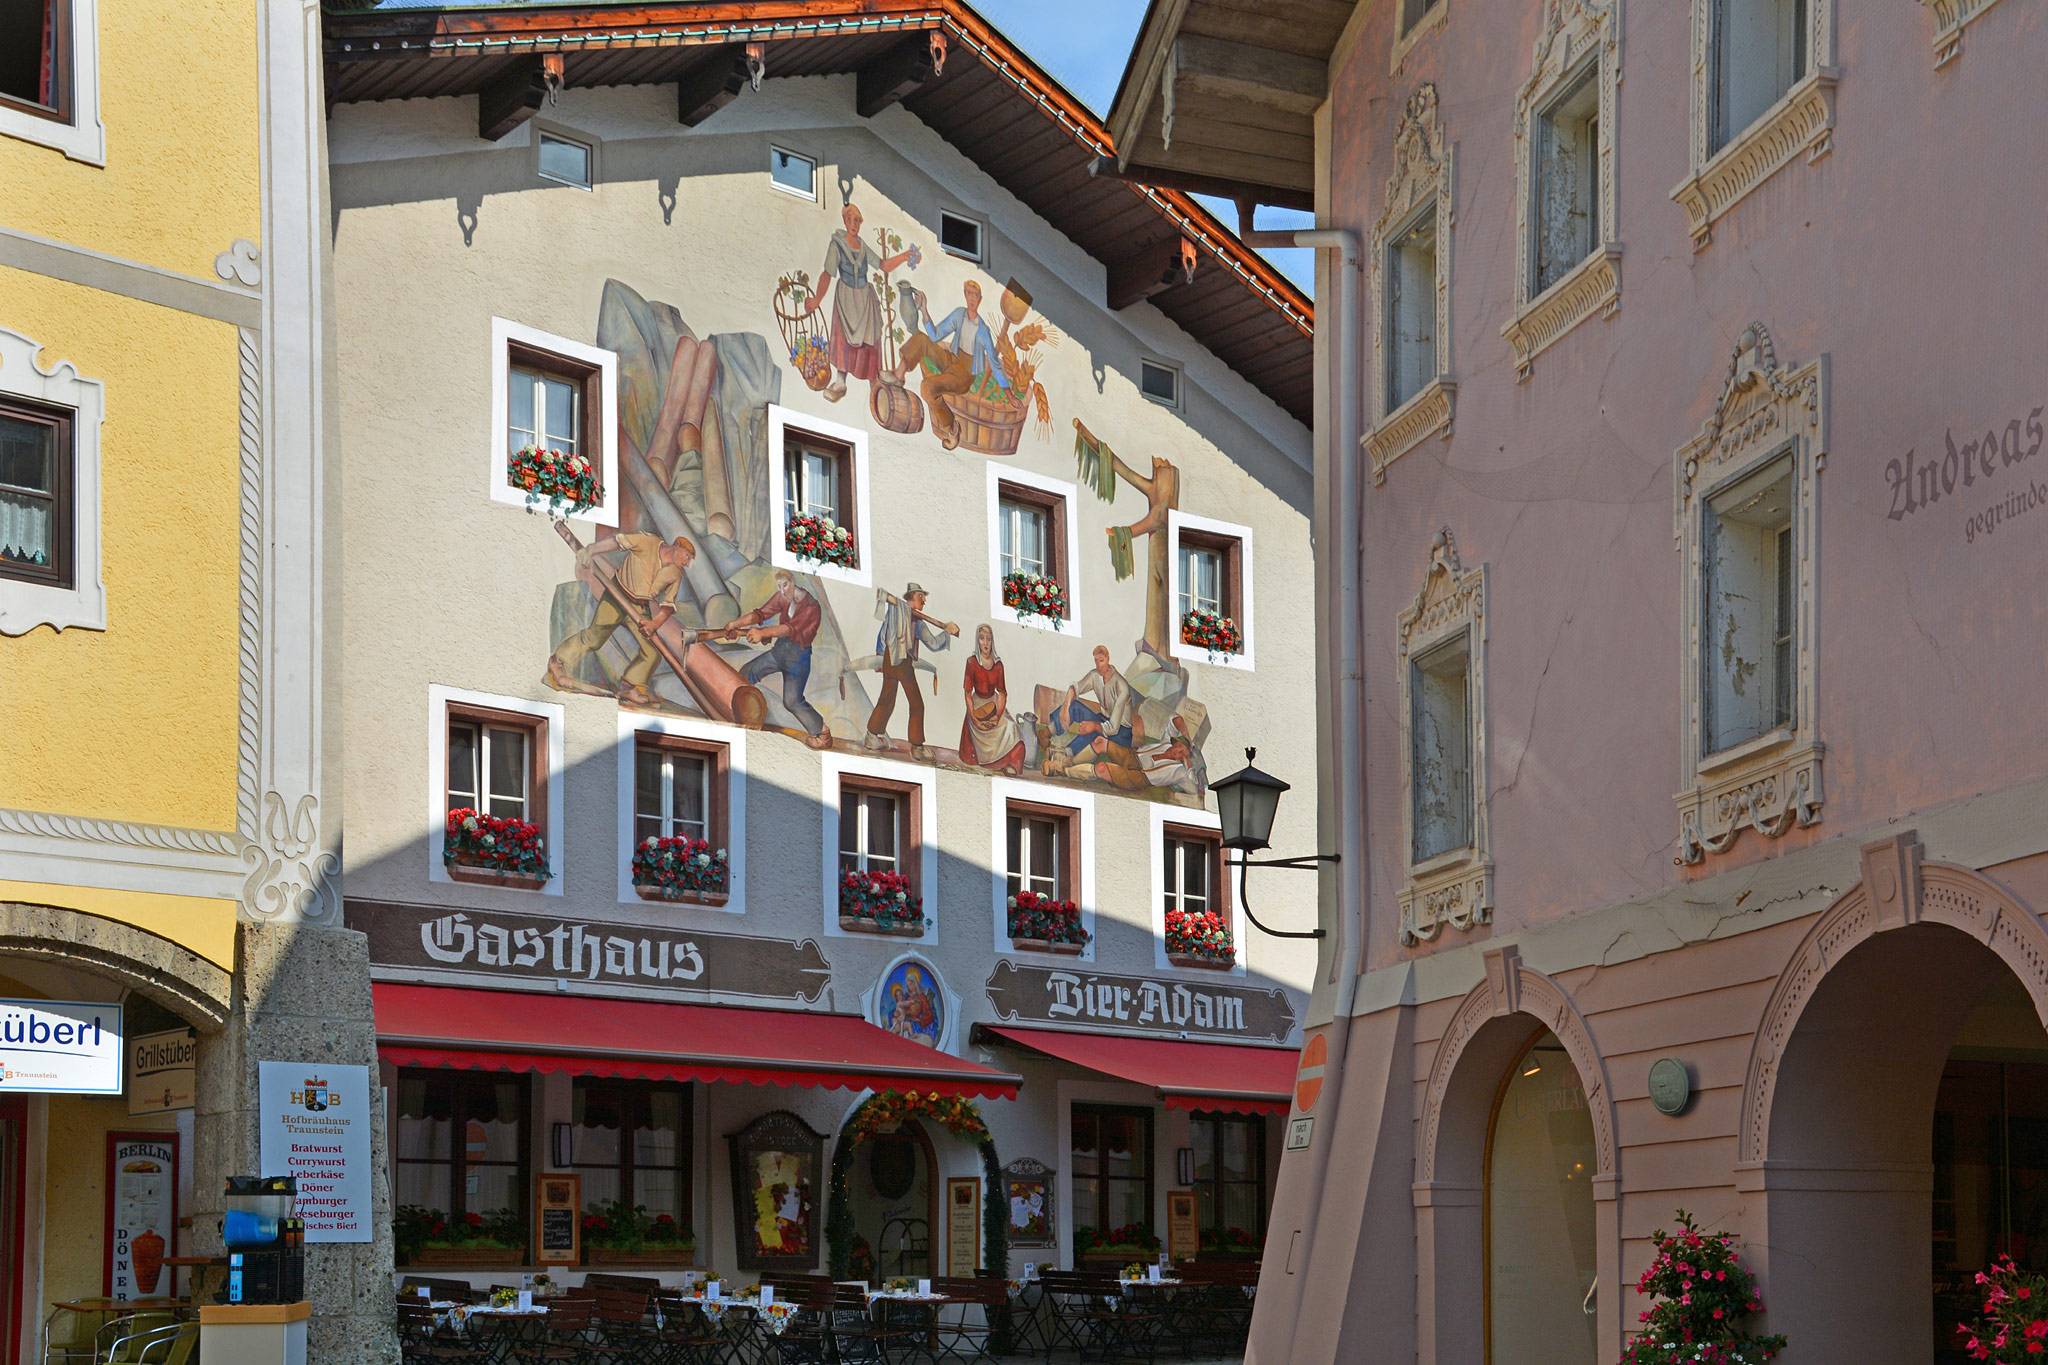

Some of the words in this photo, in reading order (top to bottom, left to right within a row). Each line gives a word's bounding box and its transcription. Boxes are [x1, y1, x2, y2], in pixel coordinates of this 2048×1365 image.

[1884, 405, 2045, 522] Andreas
[1965, 479, 2048, 544] gegründe
[419, 913, 704, 980] Gasthaus
[0, 1013, 101, 1046] überl
[136, 1040, 195, 1069] Grillstüber
[15, 1071, 58, 1079] Traunstein
[290, 1091, 304, 1104] H
[328, 1093, 341, 1106] B
[281, 1115, 351, 1126] Hofbräuhaus
[286, 1124, 344, 1134] Traunstein
[119, 1144, 171, 1162] BERLIN
[291, 1143, 343, 1153] Bratwurst
[287, 1156, 346, 1167] Currywurst
[301, 1182, 334, 1192] Döner
[295, 1197, 348, 1207] amburger
[295, 1210, 355, 1220] eeseburger
[305, 1222, 334, 1230] isches
[336, 1222, 357, 1230] Bier!
[117, 1229, 128, 1301] DÖNER
